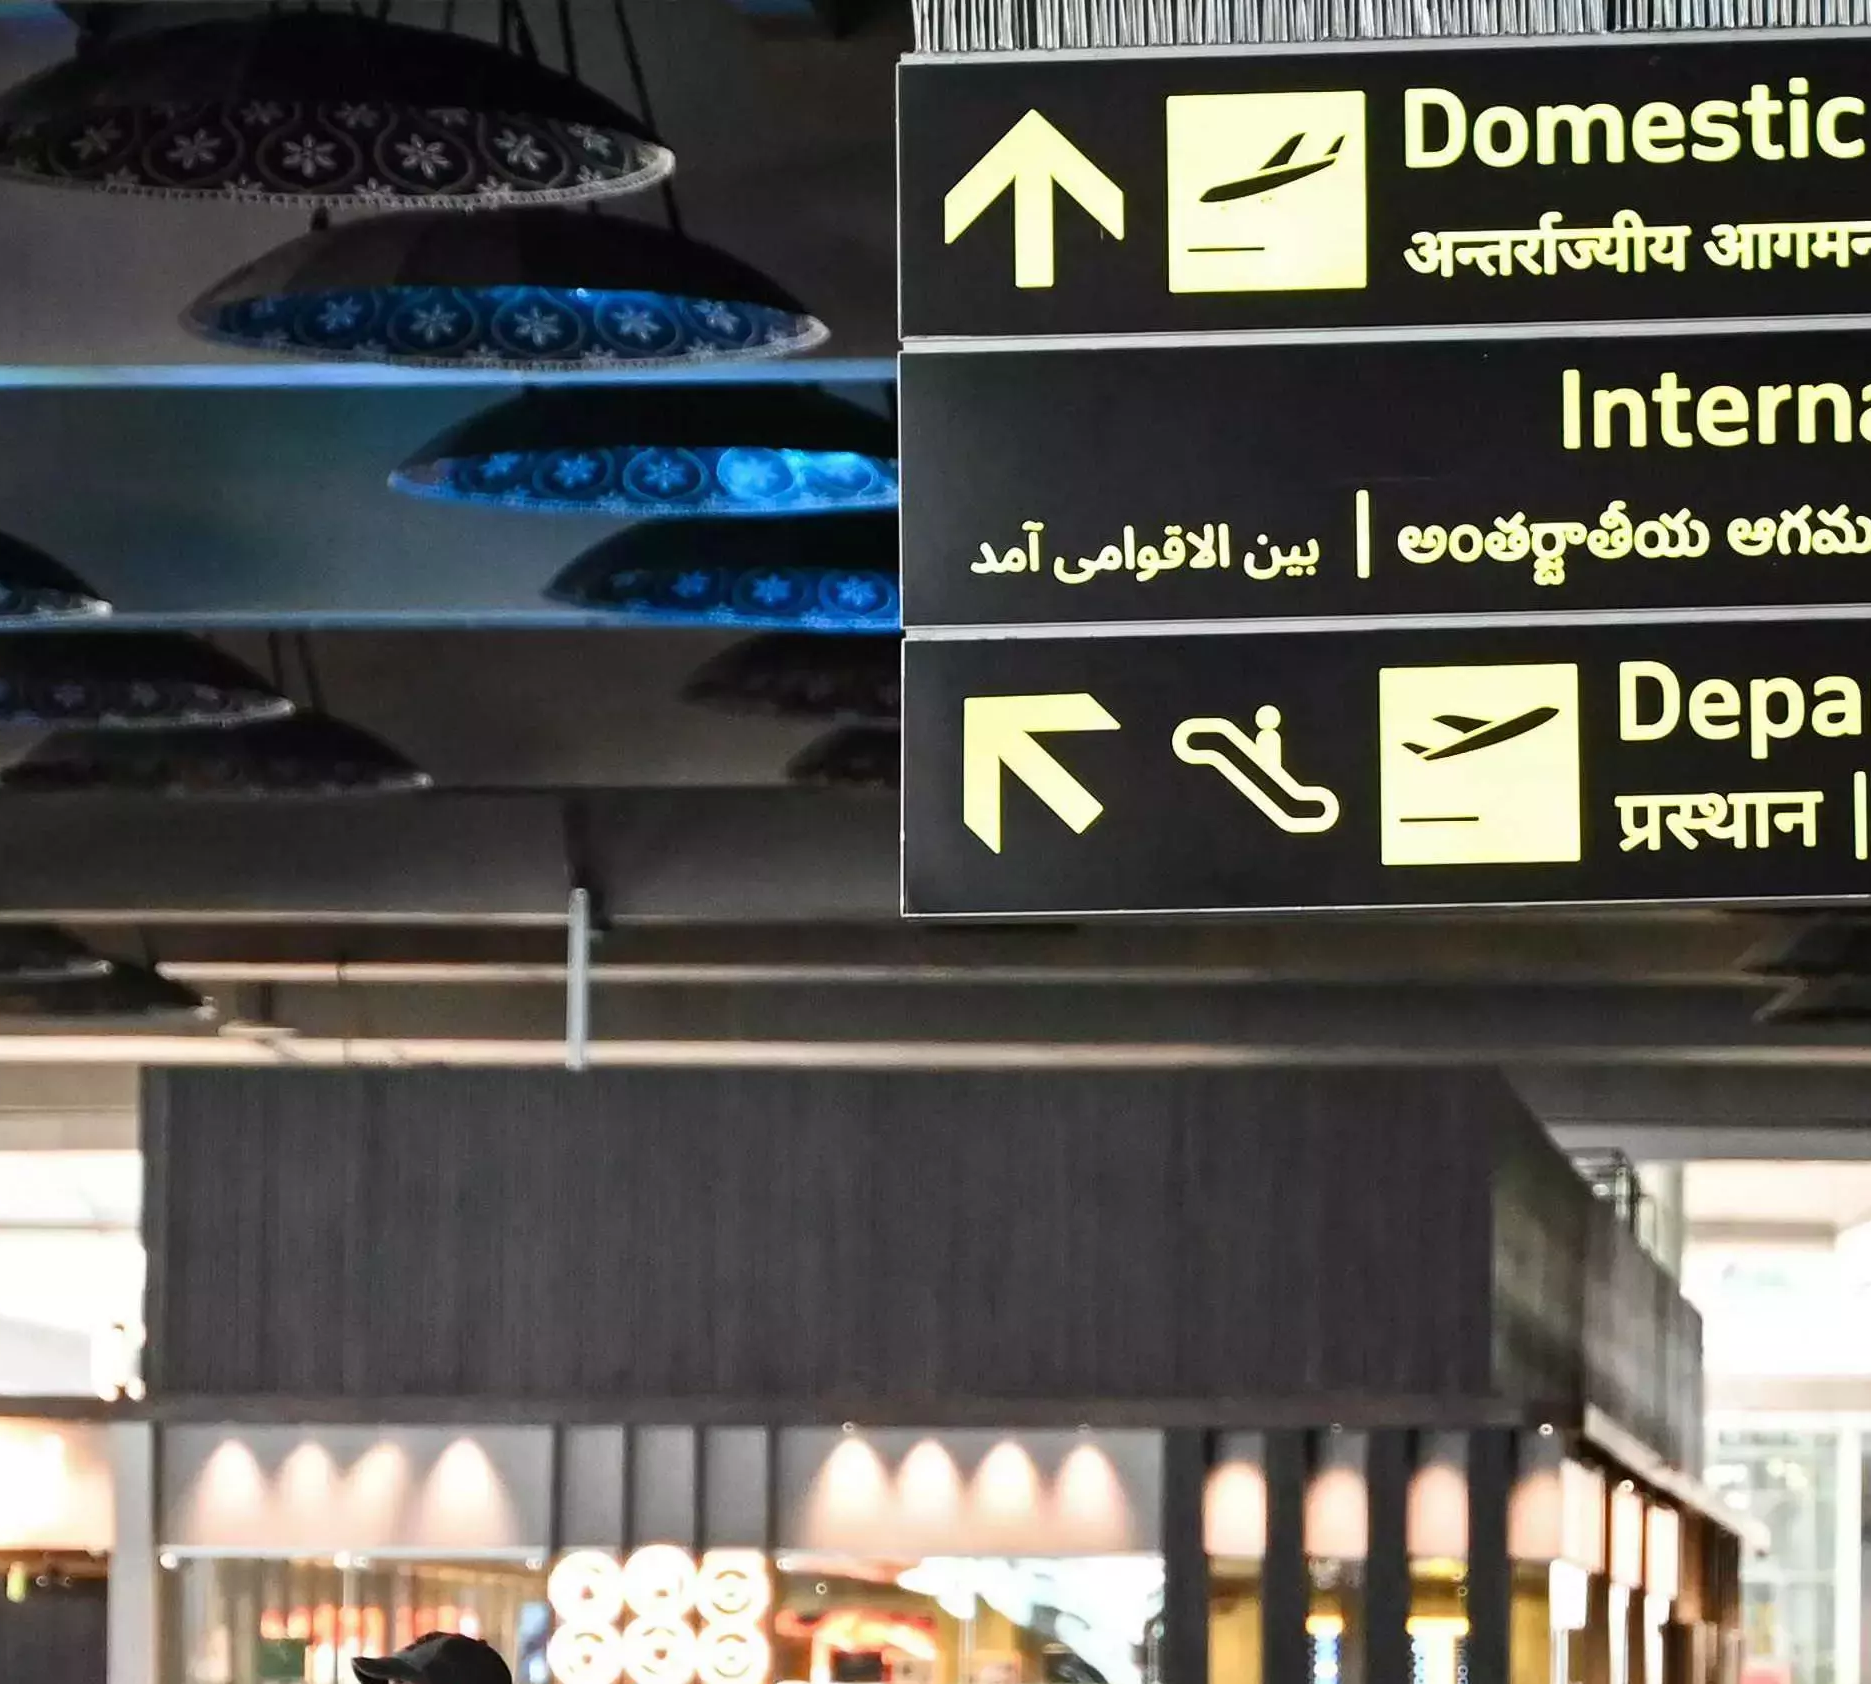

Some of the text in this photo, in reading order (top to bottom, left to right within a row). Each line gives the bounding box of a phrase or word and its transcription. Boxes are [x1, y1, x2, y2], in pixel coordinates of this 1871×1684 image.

[1404, 76, 1866, 170] Domestic
[1403, 209, 1693, 278] अन्तर्राज्यीय
[970, 520, 1320, 584] بین الاقوامی آمد
[1397, 499, 1711, 586] అంతర్జాతీయ
[1614, 790, 1825, 852] प्रस्थान
